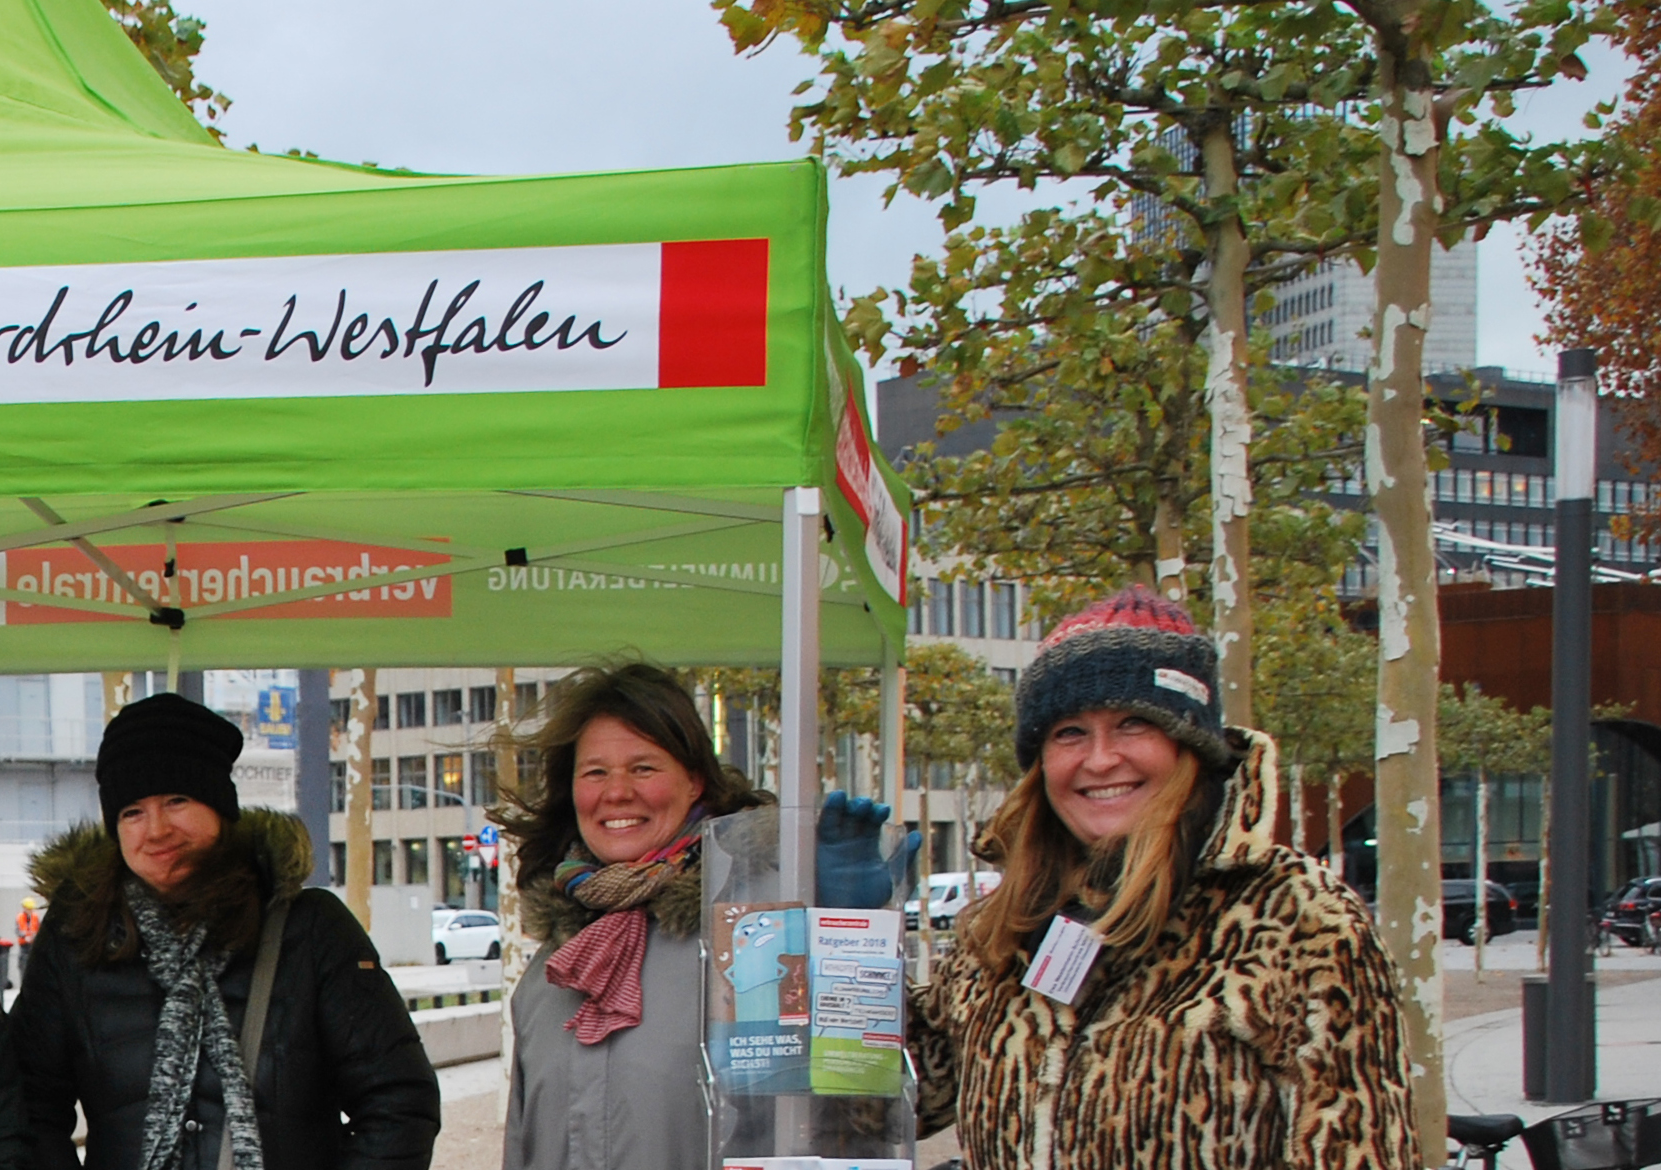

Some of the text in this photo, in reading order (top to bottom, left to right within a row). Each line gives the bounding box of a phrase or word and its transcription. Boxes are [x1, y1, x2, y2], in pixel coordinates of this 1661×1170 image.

[234, 765, 293, 781] OCHTIEF
[818, 936, 887, 948] Ratgeber 2018
[729, 1036, 748, 1046] ICH
[749, 1035, 774, 1046] SEHE
[729, 1046, 803, 1058] WAS DU NICHT
